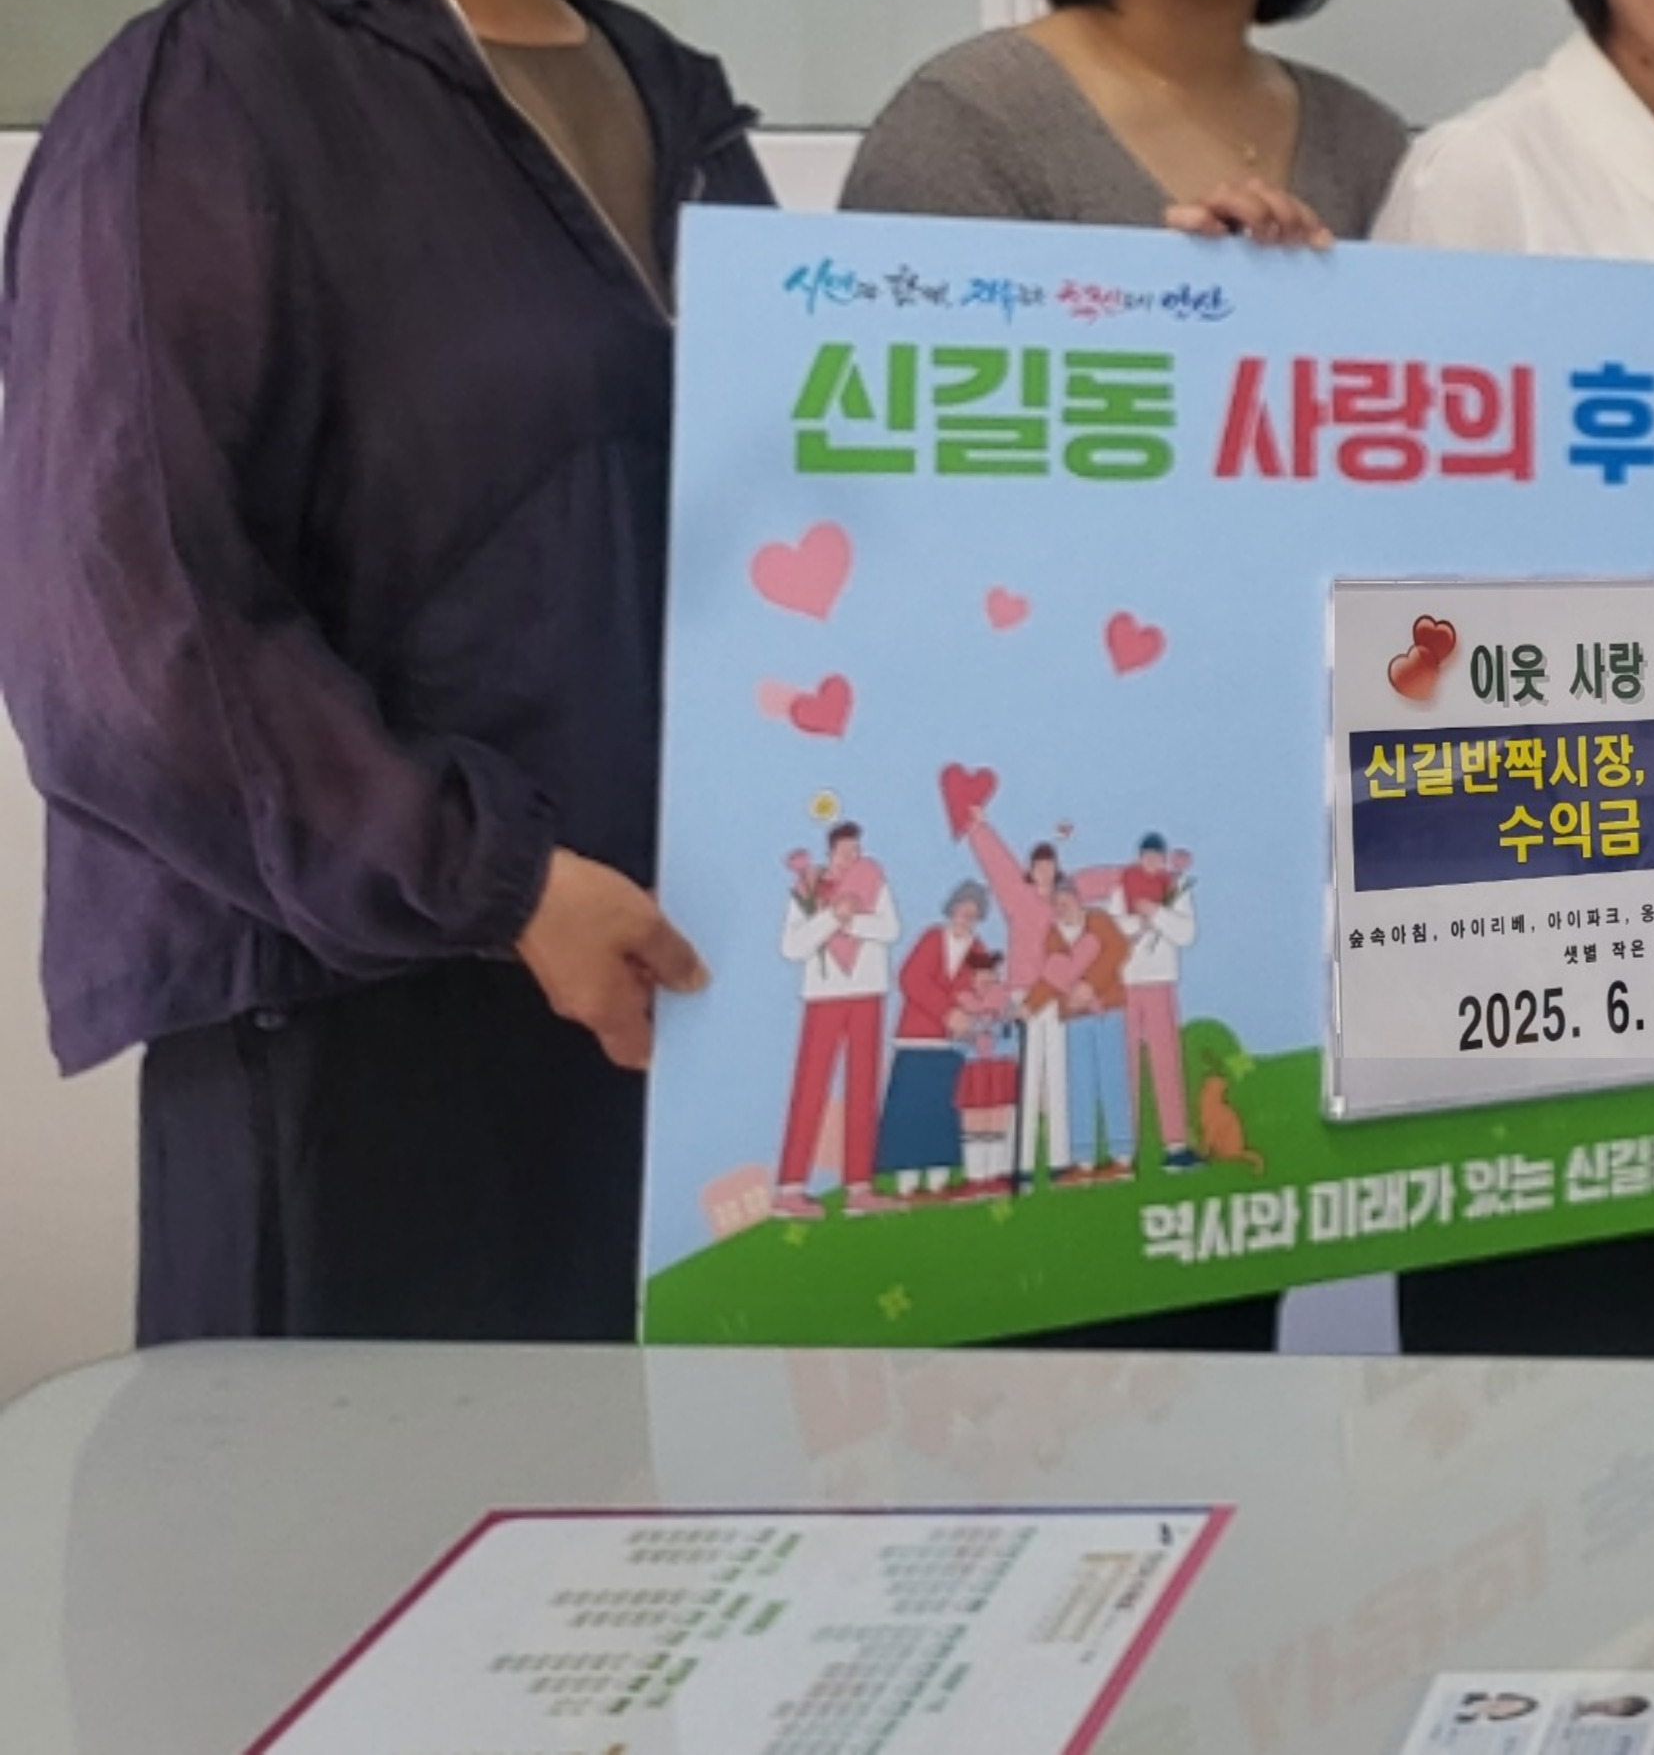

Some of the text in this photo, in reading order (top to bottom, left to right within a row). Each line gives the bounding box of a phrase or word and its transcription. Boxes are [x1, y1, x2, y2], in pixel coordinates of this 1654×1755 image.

[790, 343, 1175, 482] 신길동
[1213, 355, 1537, 482] 사랑의
[1470, 643, 1547, 705] 이웃
[1569, 641, 1645, 701] 사랑
[1364, 733, 1646, 799] 신길반짝시장,
[1498, 801, 1642, 863] 수익금
[1349, 921, 1438, 949] 숲속아침,
[1450, 913, 1536, 939] 아이리베,
[1548, 906, 1630, 930] 아이파크,
[1612, 938, 1645, 960] 작은
[1458, 987, 1581, 1051] 2025.
[1607, 979, 1646, 1035] 6.
[1140, 1185, 1300, 1265] 역사와
[1307, 1164, 1457, 1243] 미래가
[1463, 1153, 1555, 1219] 있는
